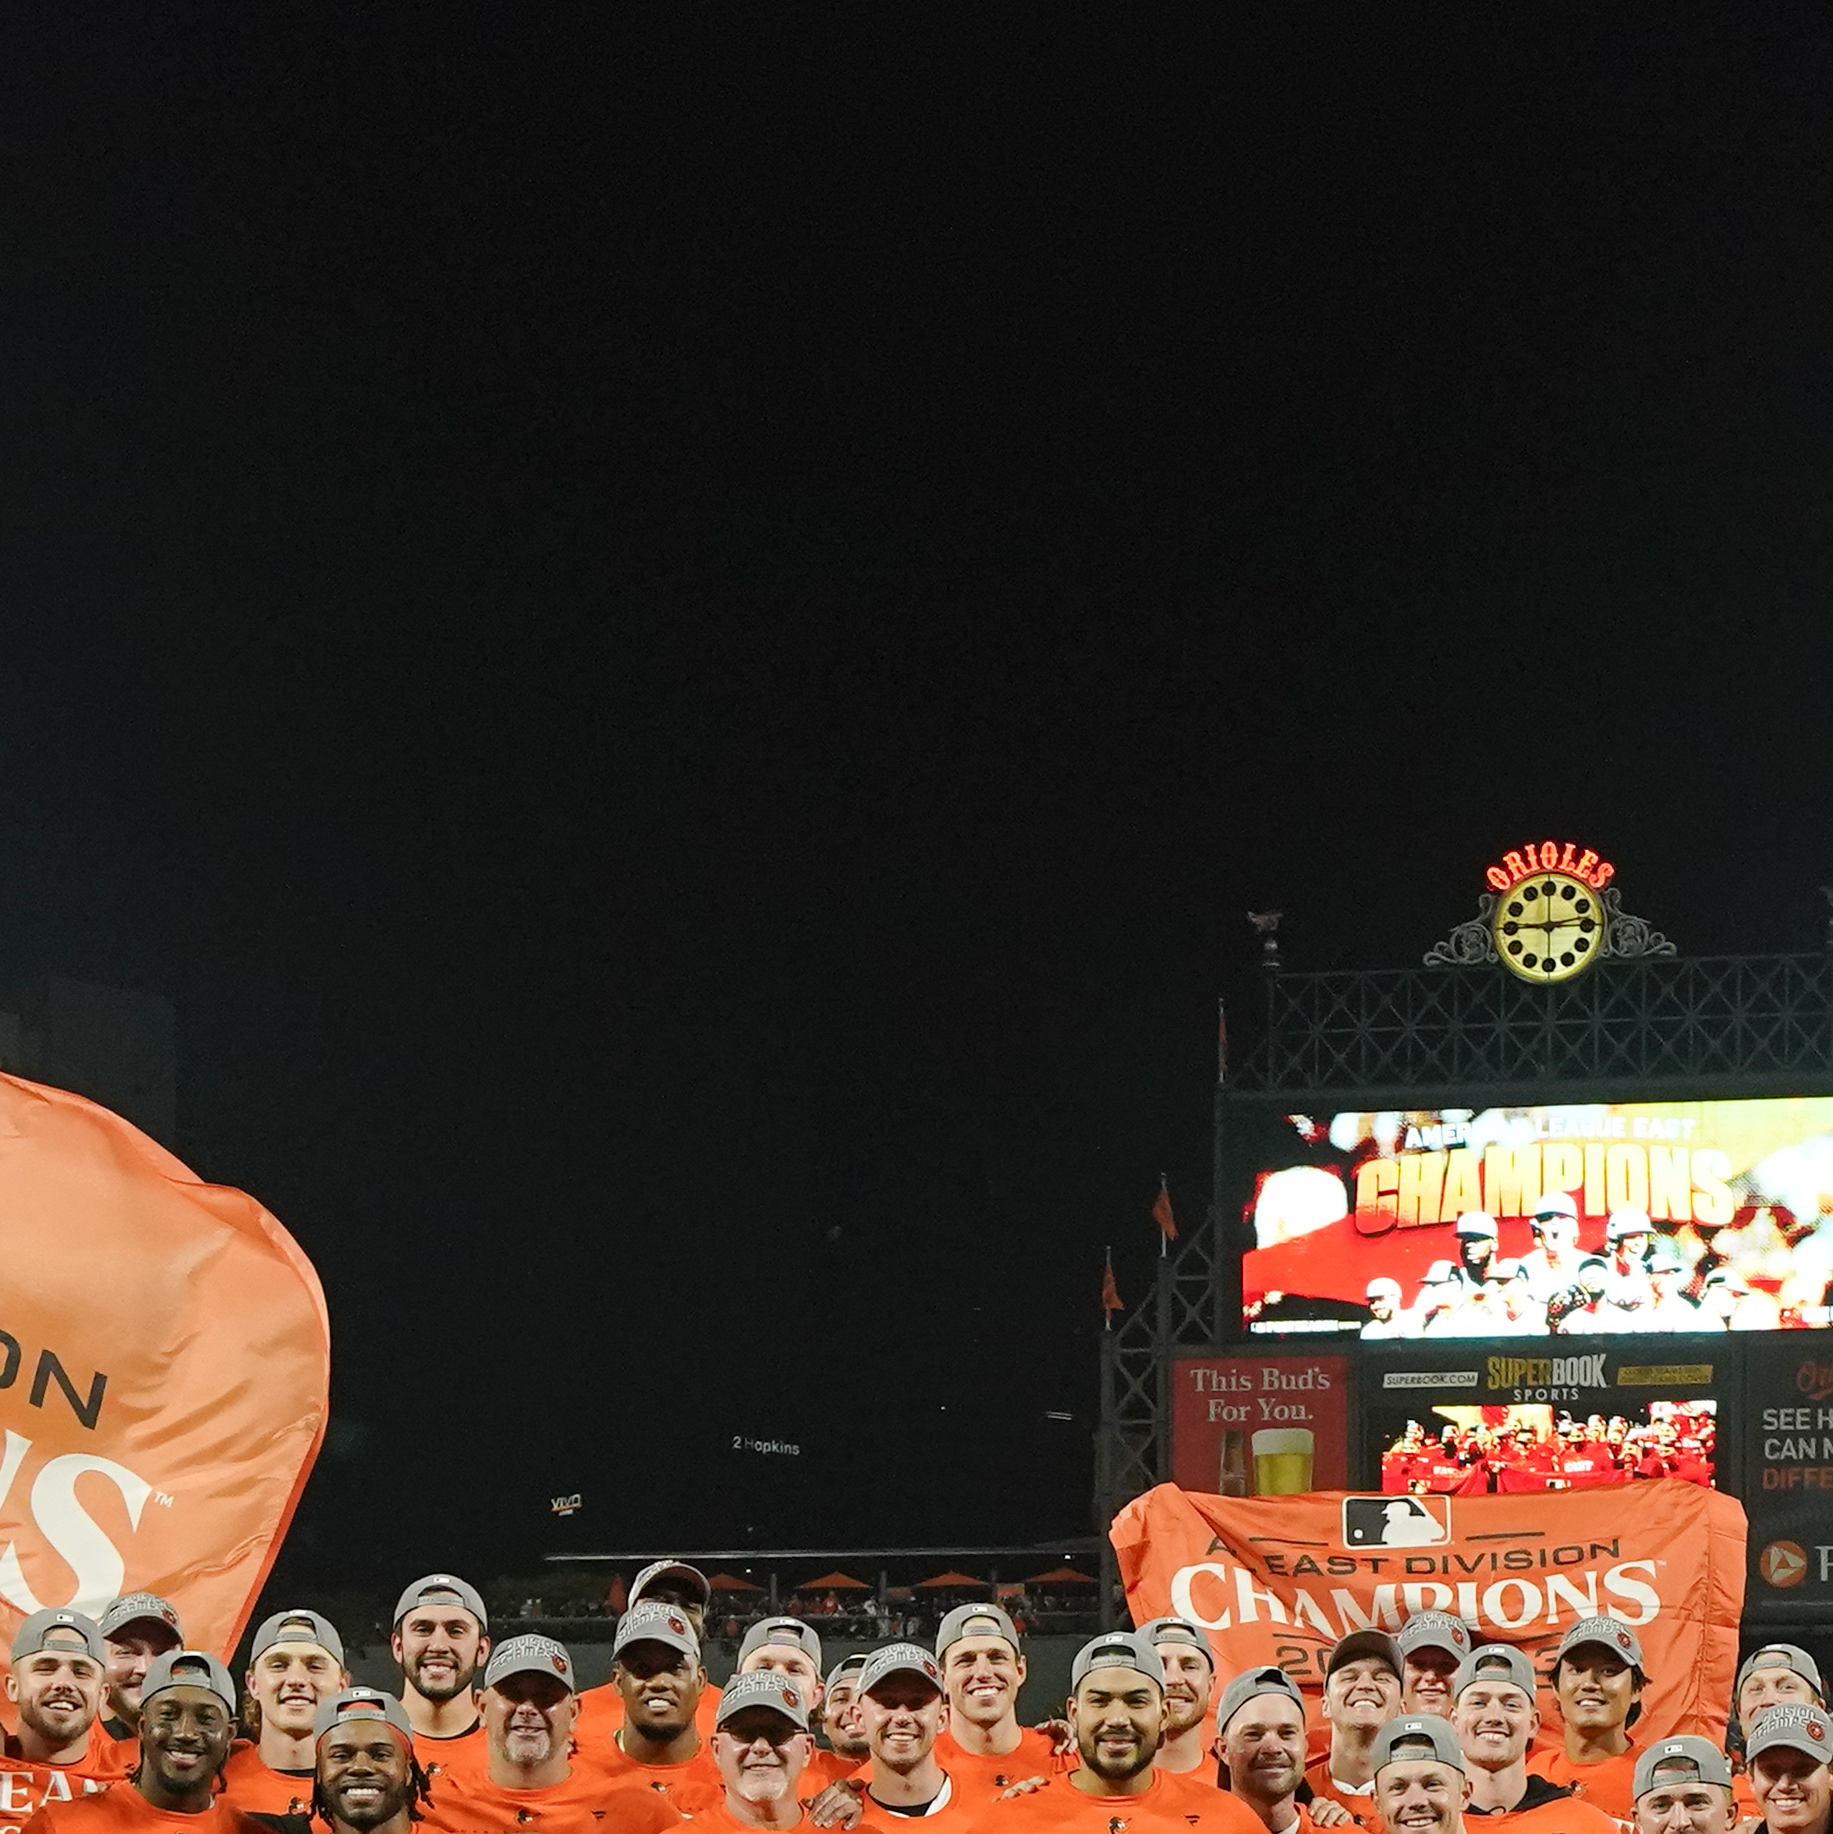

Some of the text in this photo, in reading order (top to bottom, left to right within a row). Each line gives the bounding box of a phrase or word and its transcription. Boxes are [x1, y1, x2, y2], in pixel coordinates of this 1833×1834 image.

[1486, 840, 1616, 891] ORIOLES
[1535, 1118, 1627, 1145] LEAGUE
[1631, 1116, 1697, 1140] EAST
[1355, 1143, 1736, 1238] CHAMPIONS
[1190, 1365, 1332, 1394] This Bud's
[1386, 1373, 1476, 1386] SUPERBOOK.COM
[1486, 1353, 1608, 1390] SUPERBOOK
[1513, 1388, 1580, 1402] SPORTS
[1207, 1397, 1314, 1424] For You.
[1762, 1407, 1811, 1432] SEE
[732, 1435, 801, 1456] 2 Hopkins
[1764, 1437, 1817, 1462] CAN
[1263, 1538, 1621, 1578] EAST DIVISION
[1171, 1559, 1660, 1642] CHAMPIONS
